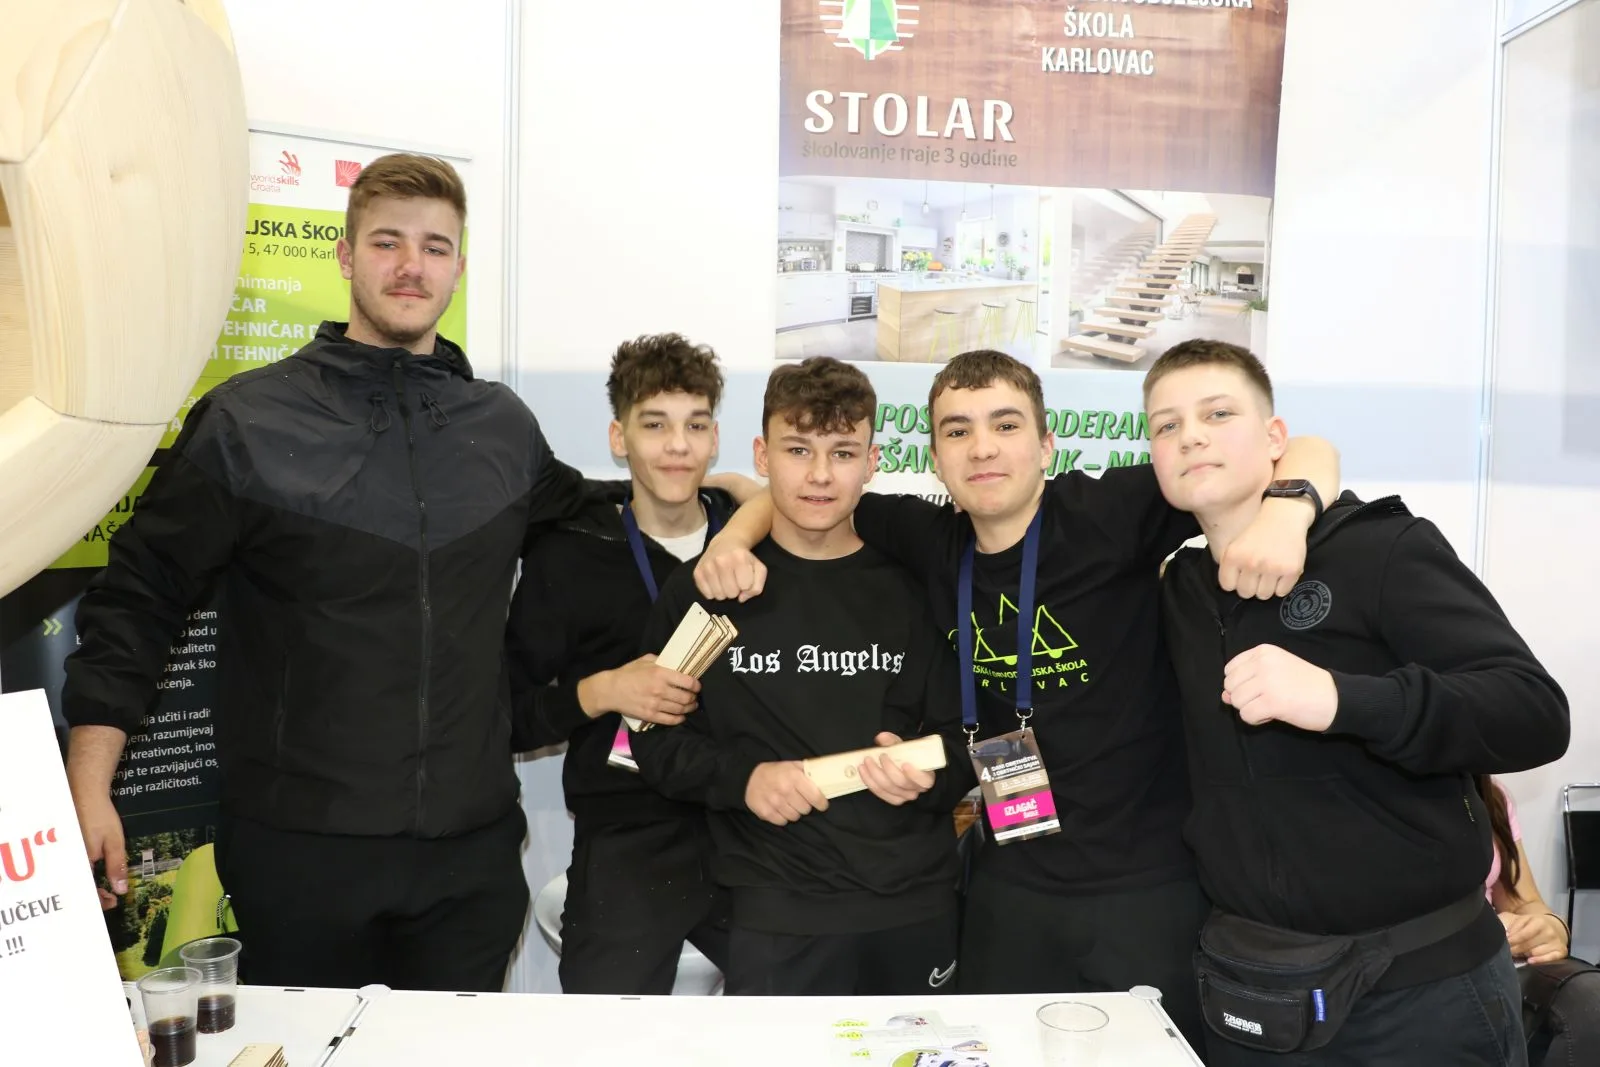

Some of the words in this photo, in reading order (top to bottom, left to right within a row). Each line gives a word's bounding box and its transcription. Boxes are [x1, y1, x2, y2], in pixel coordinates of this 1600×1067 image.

[1063, 6, 1134, 38] ŠKOLA
[1041, 45, 1155, 76] KARLOVAC
[804, 88, 1016, 142] STOLAR
[802, 140, 899, 164] školovanje
[900, 145, 941, 166] traje
[944, 147, 956, 165] 3
[958, 149, 1018, 170] godine
[248, 242, 260, 256] 5,
[263, 244, 279, 256] 47
[283, 245, 307, 258] 000
[188, 626, 208, 637] kod
[198, 658, 217, 670] ško
[728, 645, 782, 674] Los
[796, 642, 906, 677] Angeles
[1055, 658, 1088, 673] ŠKOLA
[156, 678, 195, 690] učenja.
[158, 711, 181, 724] učiti
[131, 744, 193, 761] kreativnost,
[137, 766, 148, 776] te
[150, 757, 203, 776] razvijajući
[145, 775, 203, 792] različitosti.
